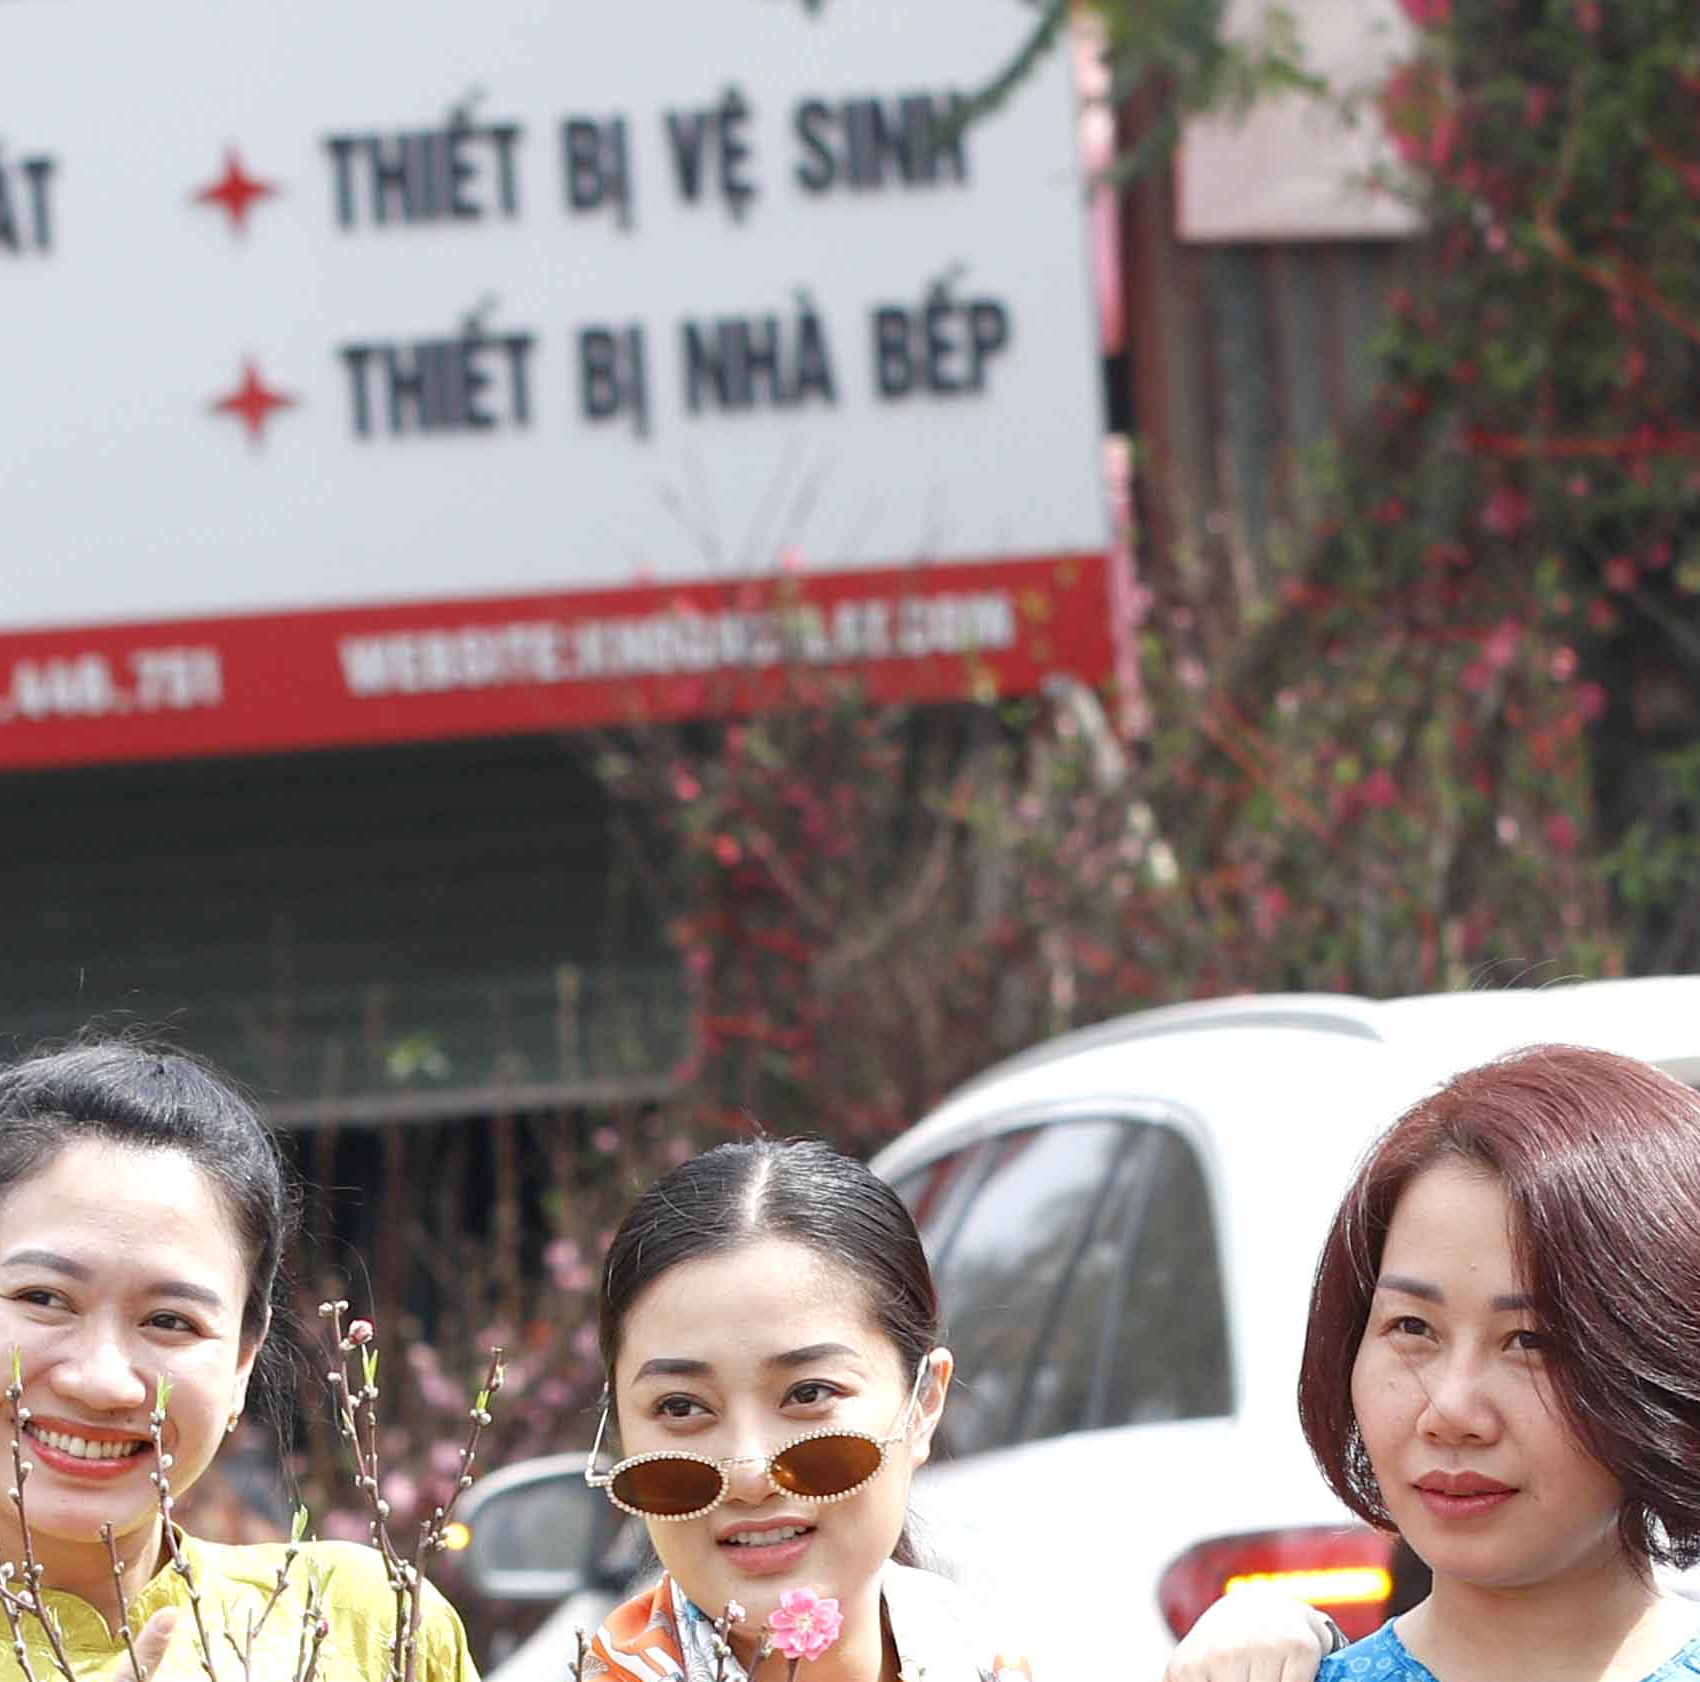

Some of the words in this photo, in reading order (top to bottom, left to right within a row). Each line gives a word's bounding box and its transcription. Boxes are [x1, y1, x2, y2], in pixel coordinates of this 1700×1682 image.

[322, 92, 523, 230] THIẾT
[560, 116, 633, 233] BỊ
[664, 86, 758, 224] VỆ
[792, 91, 972, 197] SINH
[338, 298, 537, 441] THIẾT
[576, 325, 650, 442] BỊ
[679, 290, 841, 417] NHÀ
[870, 265, 1013, 402] BẾP
